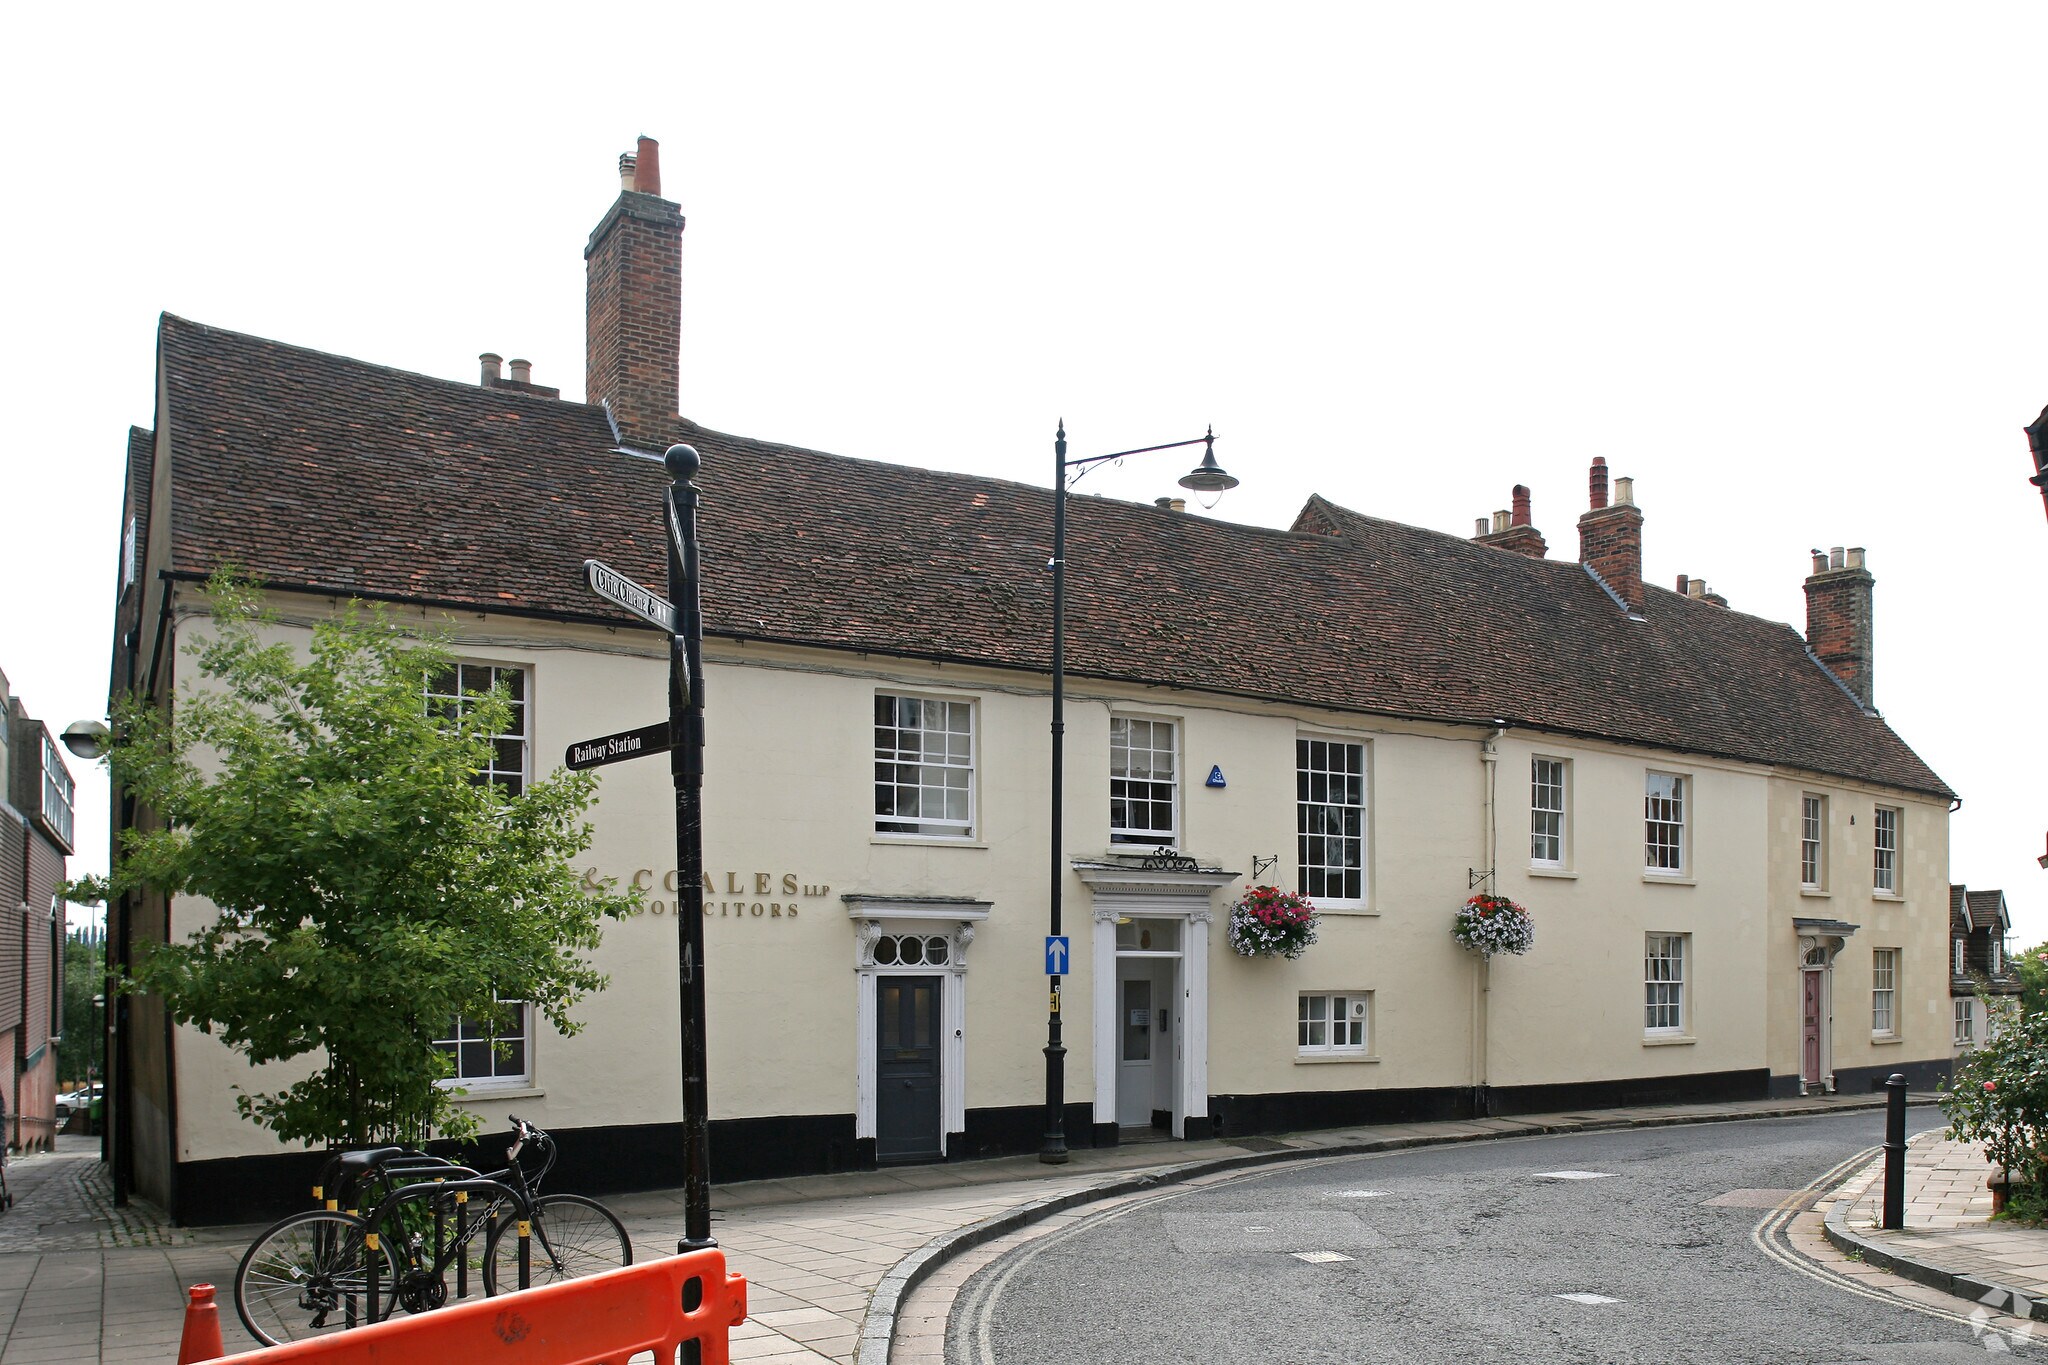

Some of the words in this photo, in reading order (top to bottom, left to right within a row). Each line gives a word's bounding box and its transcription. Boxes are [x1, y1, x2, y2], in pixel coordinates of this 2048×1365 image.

[619, 580, 647, 612] Cinema
[647, 598, 657, 616] &
[574, 744, 607, 763] Railway
[608, 736, 641, 755] Station
[578, 866, 619, 891] &
[803, 884, 830, 896] LLP
[634, 900, 798, 917] SOCITORS
[455, 1194, 507, 1252] ridgebac
